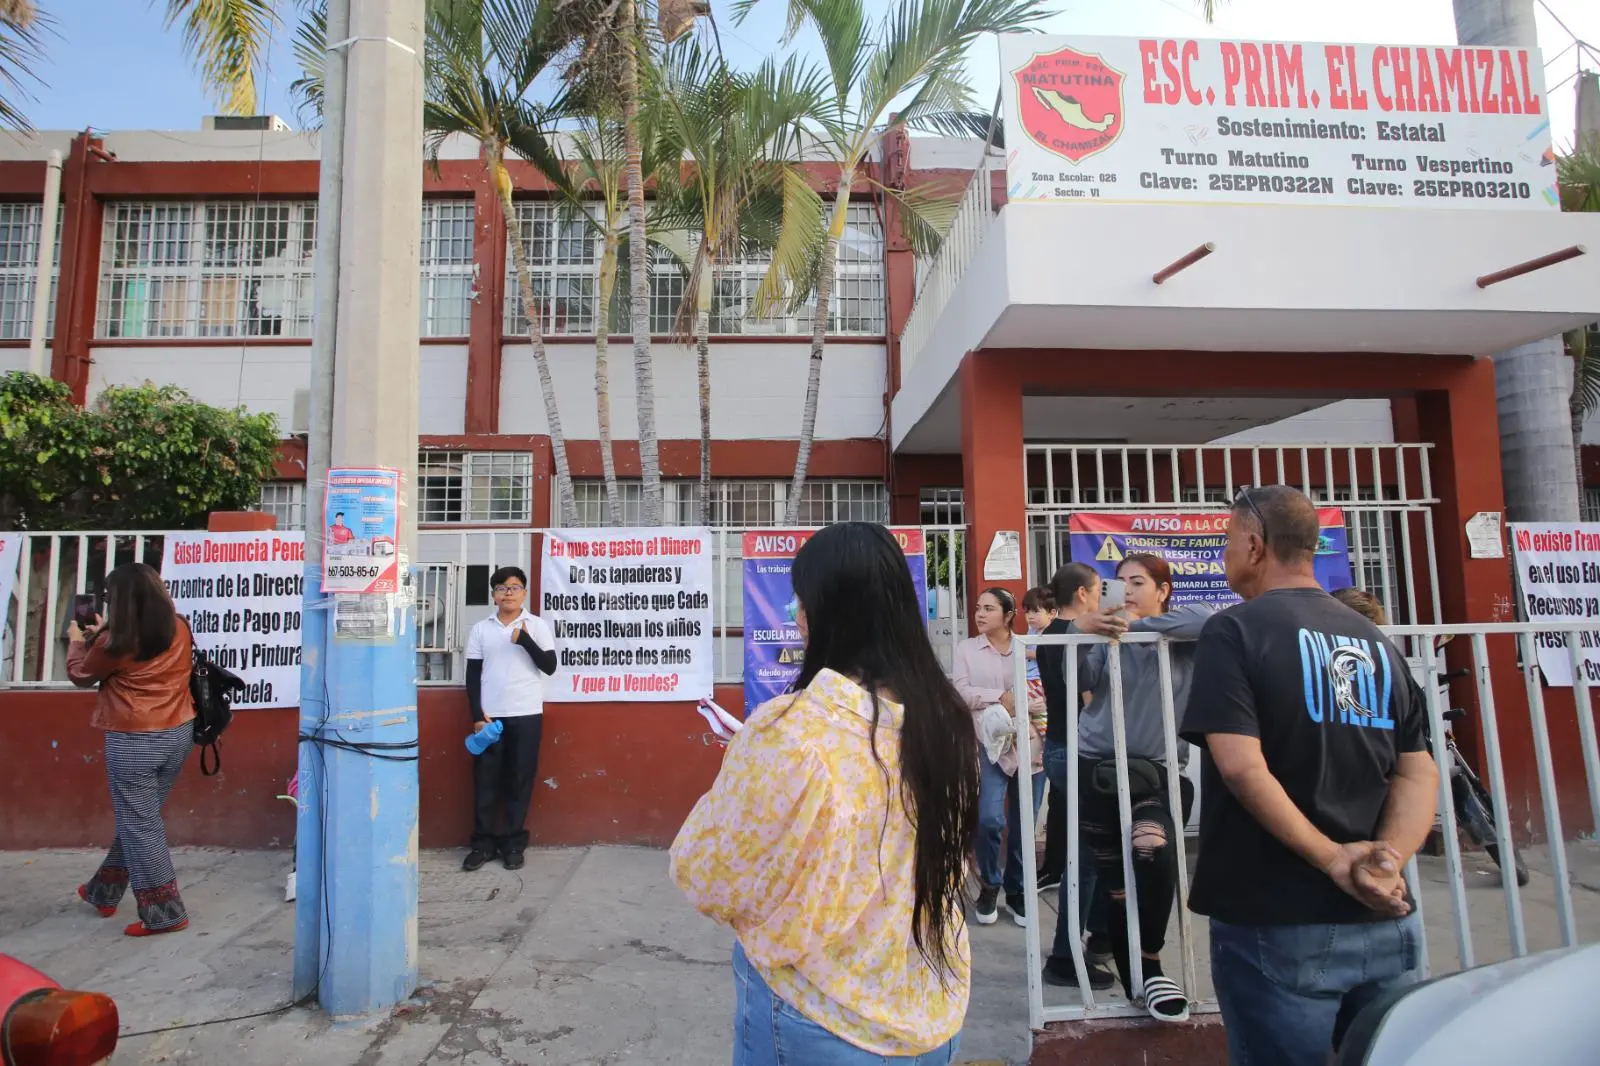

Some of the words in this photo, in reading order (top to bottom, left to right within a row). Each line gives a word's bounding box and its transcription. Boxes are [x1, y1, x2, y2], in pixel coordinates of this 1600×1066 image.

[1023, 73, 1114, 86] MATUTINA
[1139, 40, 1216, 105] ESC.
[1220, 42, 1320, 109] PRIM.
[1324, 45, 1368, 110] EL
[1372, 46, 1540, 114] CHAMIZAL
[1217, 116, 1366, 140] Sostenimiento:
[1376, 121, 1446, 142] Estatal
[1160, 148, 1217, 166] Turno
[1228, 150, 1309, 168] Matutino
[1352, 154, 1407, 171] Turno
[1416, 156, 1513, 176] Vespertino
[1032, 172, 1054, 182] Zona
[1059, 172, 1095, 182] Escolar:
[1100, 173, 1117, 182] 026
[1140, 172, 1198, 190] Clave:
[1347, 178, 1404, 196] Clave:
[1055, 188, 1086, 197] Sector:
[1131, 518, 1180, 531] AVISO
[1184, 520, 1192, 530] A
[1195, 520, 1210, 530] LA
[203, 539, 268, 563] Denuncia
[551, 538, 564, 557] En
[567, 540, 589, 559] que
[592, 540, 606, 557] se
[610, 538, 643, 558] gasto
[646, 537, 658, 555] el
[660, 536, 702, 555] Dinero
[754, 535, 796, 553] AVISO
[1125, 537, 1167, 547] PADRES
[1170, 538, 1185, 547] DE
[1516, 530, 1531, 551] NO
[1533, 530, 1572, 552] existe
[1164, 550, 1211, 559] RESPETO
[1214, 550, 1220, 558] Y
[569, 565, 586, 584] De
[588, 565, 607, 584] las
[609, 564, 672, 586] tapaderas
[674, 567, 682, 584] y
[1556, 565, 1580, 583] uso
[181, 576, 213, 599] contra
[217, 574, 233, 597] de
[237, 574, 250, 597] la
[1171, 581, 1208, 589] RIMARIA
[544, 592, 579, 611] Botes
[581, 593, 596, 611] de
[598, 592, 648, 611] Plastico
[651, 595, 675, 612] que
[677, 591, 709, 609] Cada
[1177, 593, 1203, 602] padres
[1584, 597, 1600, 618] ya
[193, 610, 219, 633] Falta
[223, 609, 240, 632] de
[243, 608, 281, 634] Pago
[554, 619, 601, 638] Viernes
[604, 620, 642, 638] llevan
[644, 619, 664, 637] los
[666, 617, 702, 637] niños
[753, 629, 785, 641] ESCUELA
[241, 647, 249, 670] y
[561, 647, 599, 666] desde
[602, 647, 633, 666] Hace
[635, 646, 658, 665] dos
[661, 645, 691, 664] años
[572, 674, 580, 692] Y
[581, 675, 605, 694] que
[608, 675, 621, 692] tu
[623, 673, 679, 692] Vendes?
